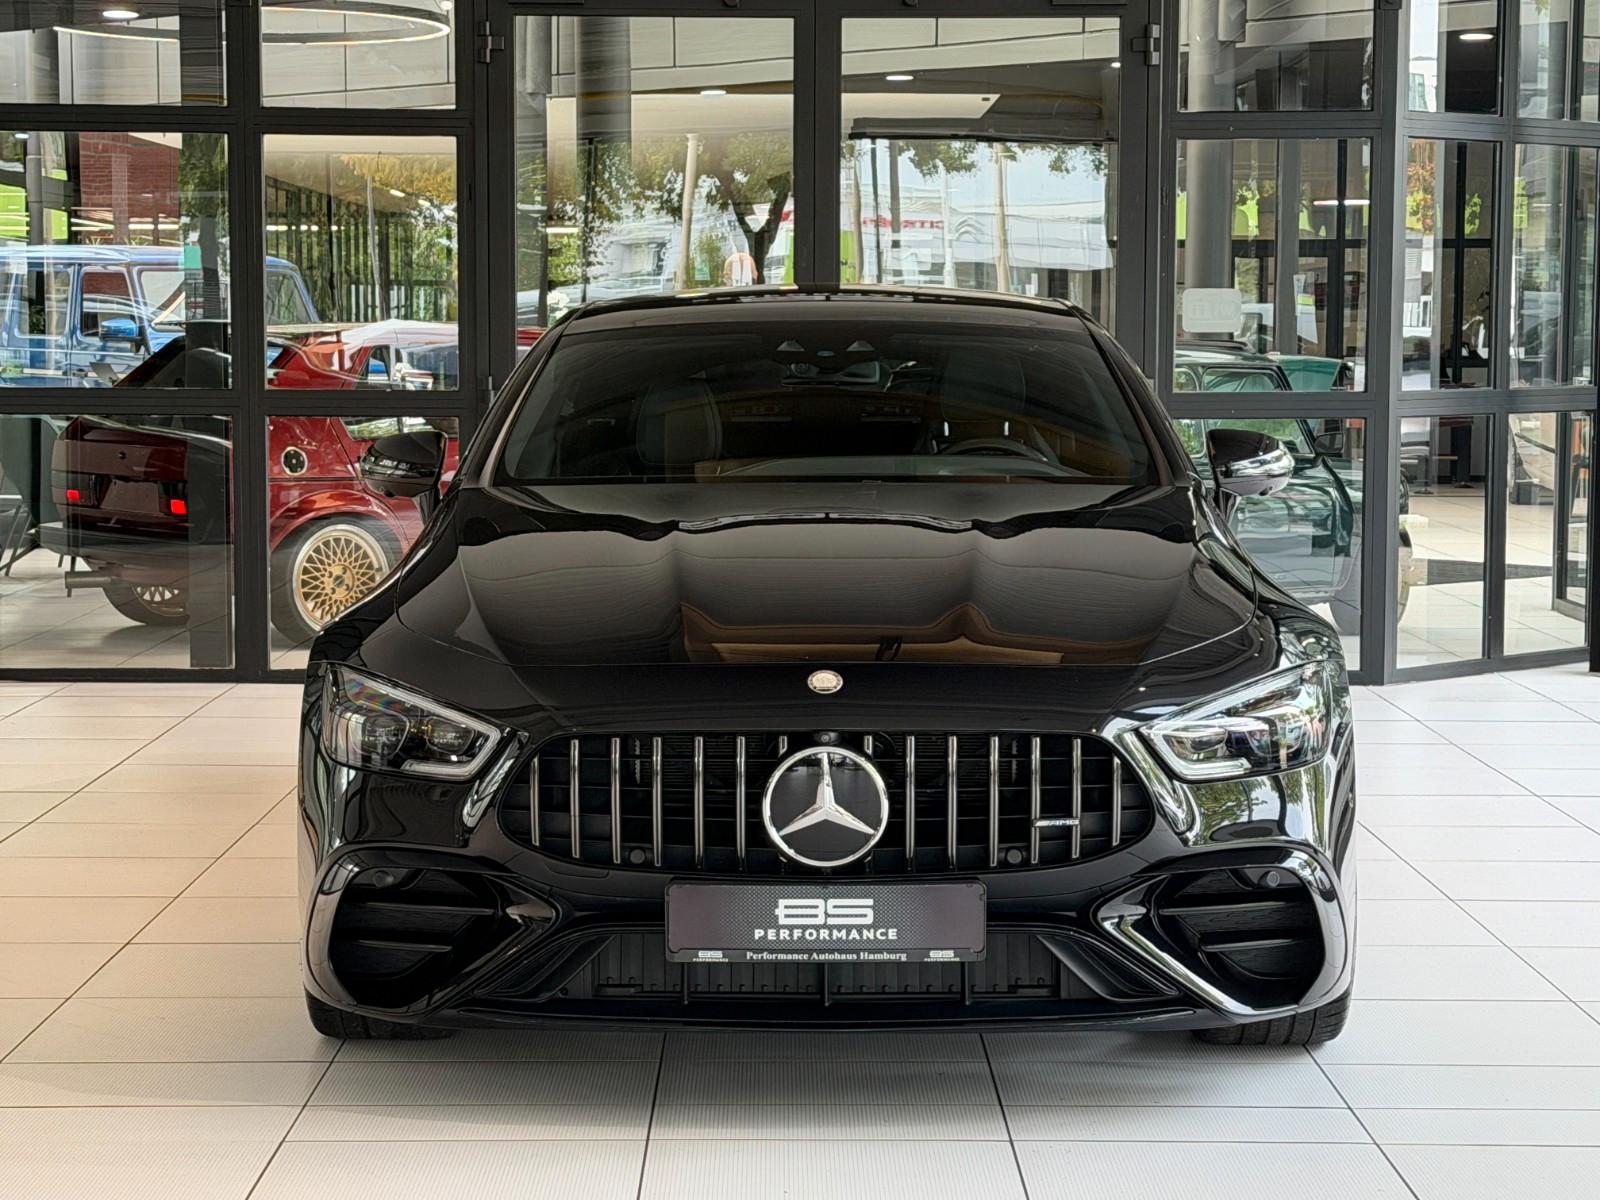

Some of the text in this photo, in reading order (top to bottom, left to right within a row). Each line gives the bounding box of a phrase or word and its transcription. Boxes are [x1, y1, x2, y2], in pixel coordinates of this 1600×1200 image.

[754, 928, 898, 941] PERFORMANCE
[746, 951, 907, 962] Performance Autohaus Hamburg
